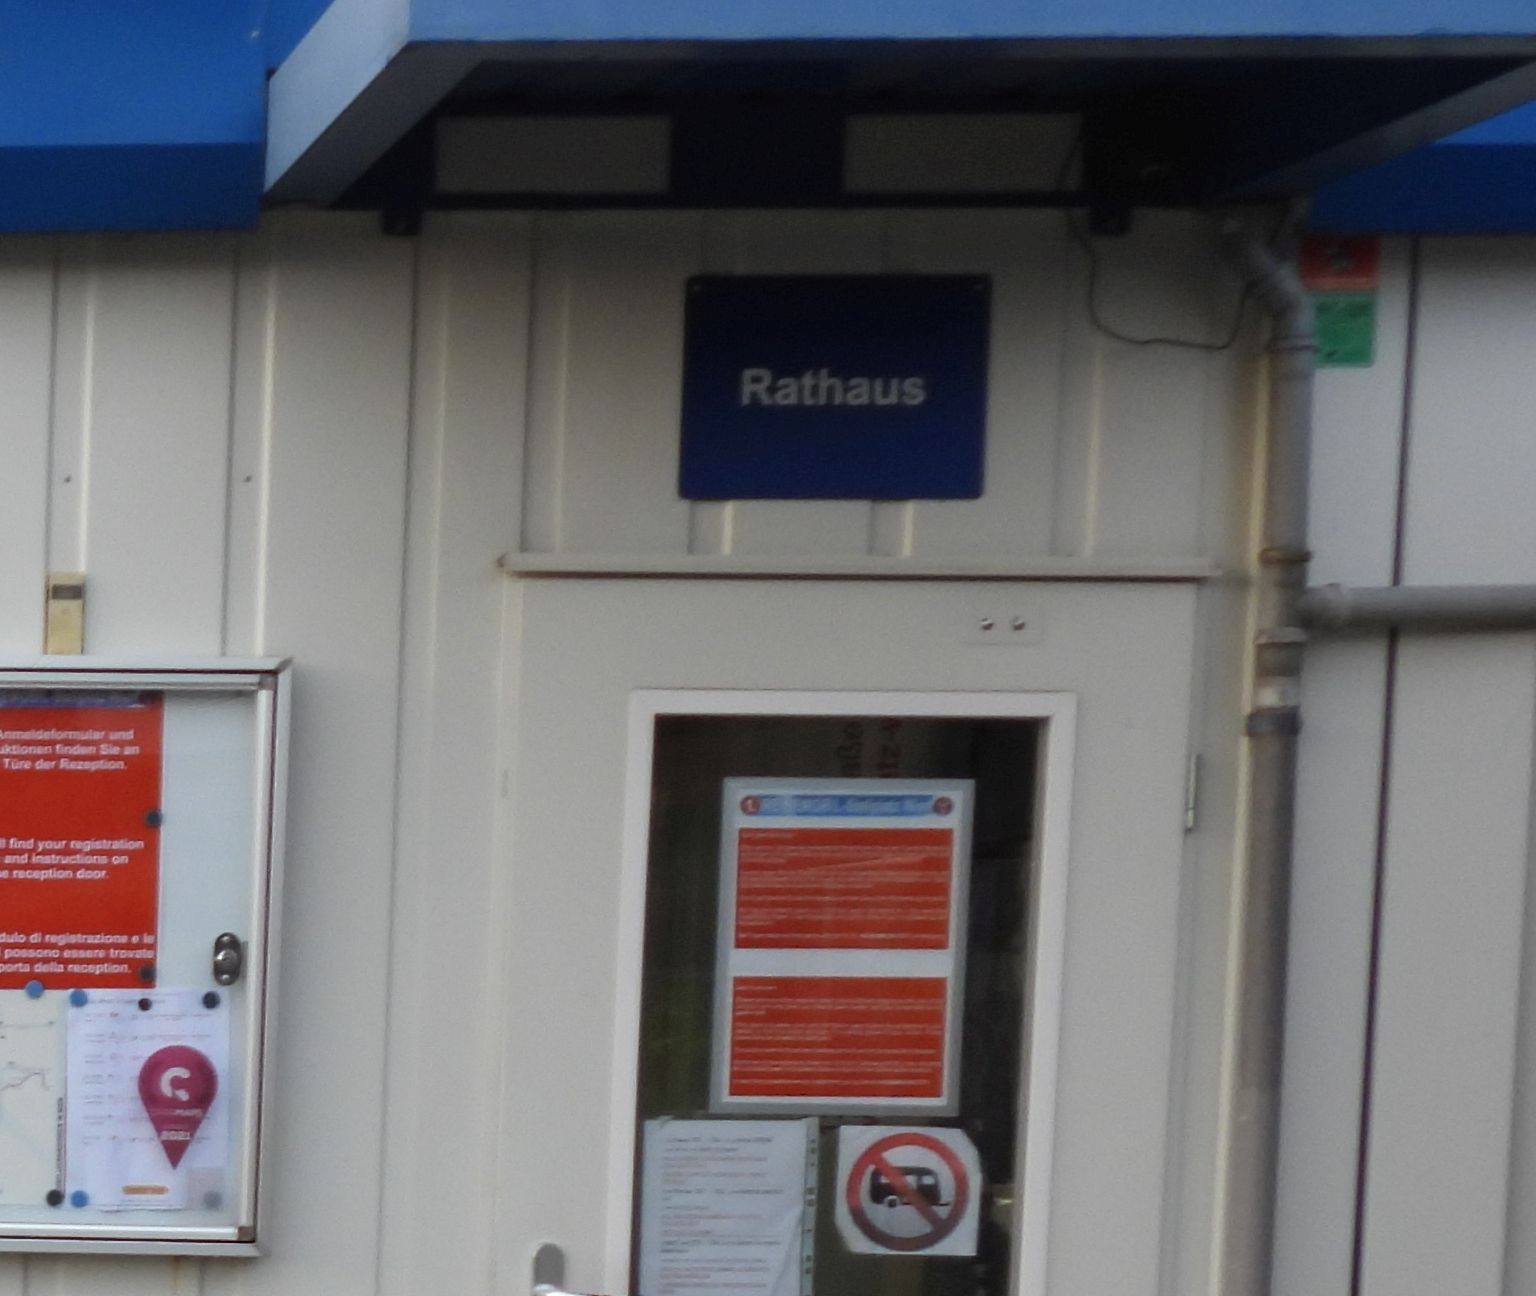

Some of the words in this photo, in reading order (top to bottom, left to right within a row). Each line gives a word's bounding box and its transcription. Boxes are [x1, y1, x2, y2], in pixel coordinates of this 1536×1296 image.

[740, 368, 928, 406] Rathaus
[108, 729, 134, 740] und
[56, 744, 97, 755] finden
[99, 744, 120, 755] Sie
[123, 746, 140, 755] an
[3, 758, 31, 769] Türe
[35, 758, 56, 769] der
[9, 838, 34, 849] find
[37, 840, 67, 851] your
[70, 838, 144, 852] registration
[4, 853, 28, 864] and
[32, 853, 108, 864] instructions
[112, 854, 129, 864] on
[13, 868, 73, 881] reception
[29, 932, 42, 943] di
[4, 949, 60, 959] possono
[63, 949, 106, 958] essere
